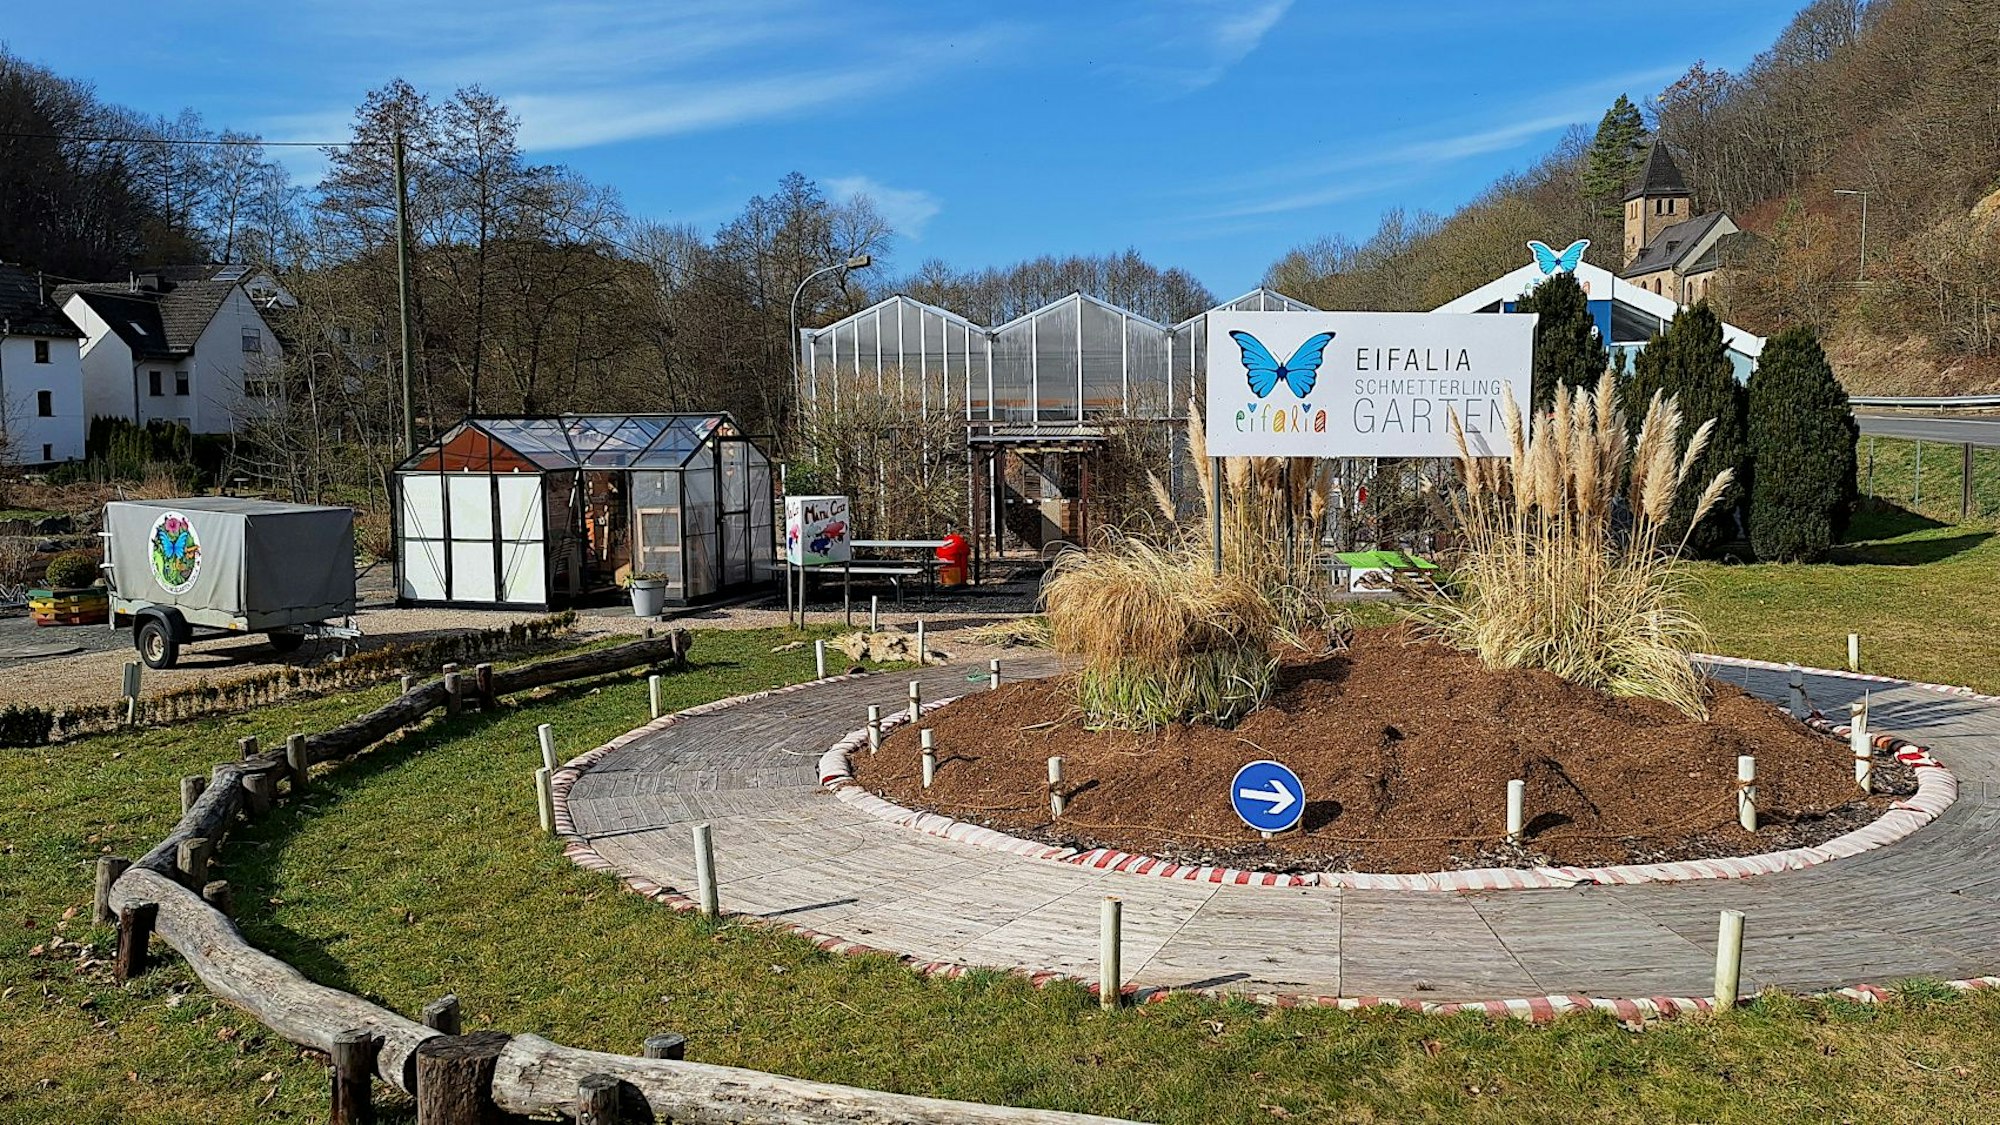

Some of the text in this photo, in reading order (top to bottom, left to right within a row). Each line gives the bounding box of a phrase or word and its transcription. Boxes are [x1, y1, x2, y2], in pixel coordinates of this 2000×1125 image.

[1356, 348, 1471, 371] EIFALIA
[1236, 402, 1326, 433] eifalia
[1353, 398, 1507, 433] GARTEN
[804, 502, 829, 525] Mini
[830, 500, 846, 516] Car
